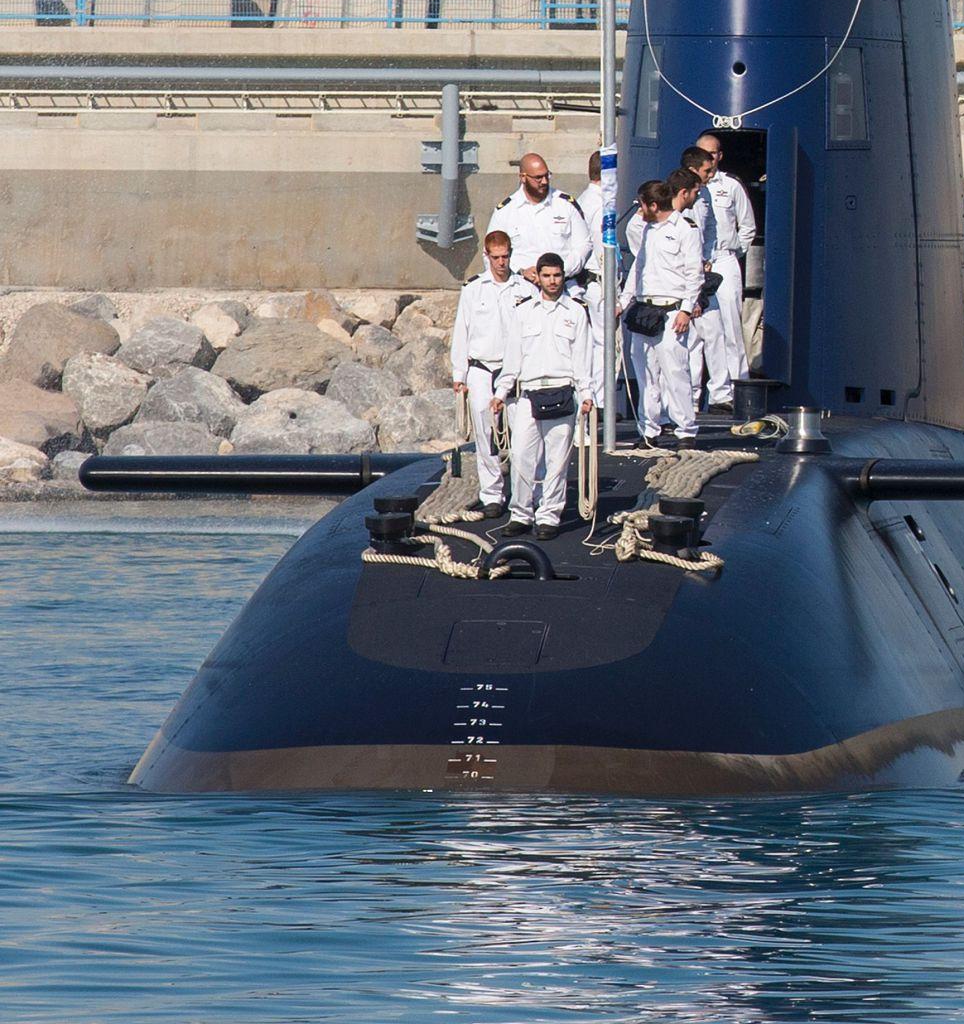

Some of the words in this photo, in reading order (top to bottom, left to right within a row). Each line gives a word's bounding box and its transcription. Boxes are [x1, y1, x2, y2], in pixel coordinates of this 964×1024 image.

[476, 683, 493, 691] 75
[470, 718, 487, 726] 73
[467, 736, 484, 744] 72
[465, 754, 481, 762] 71
